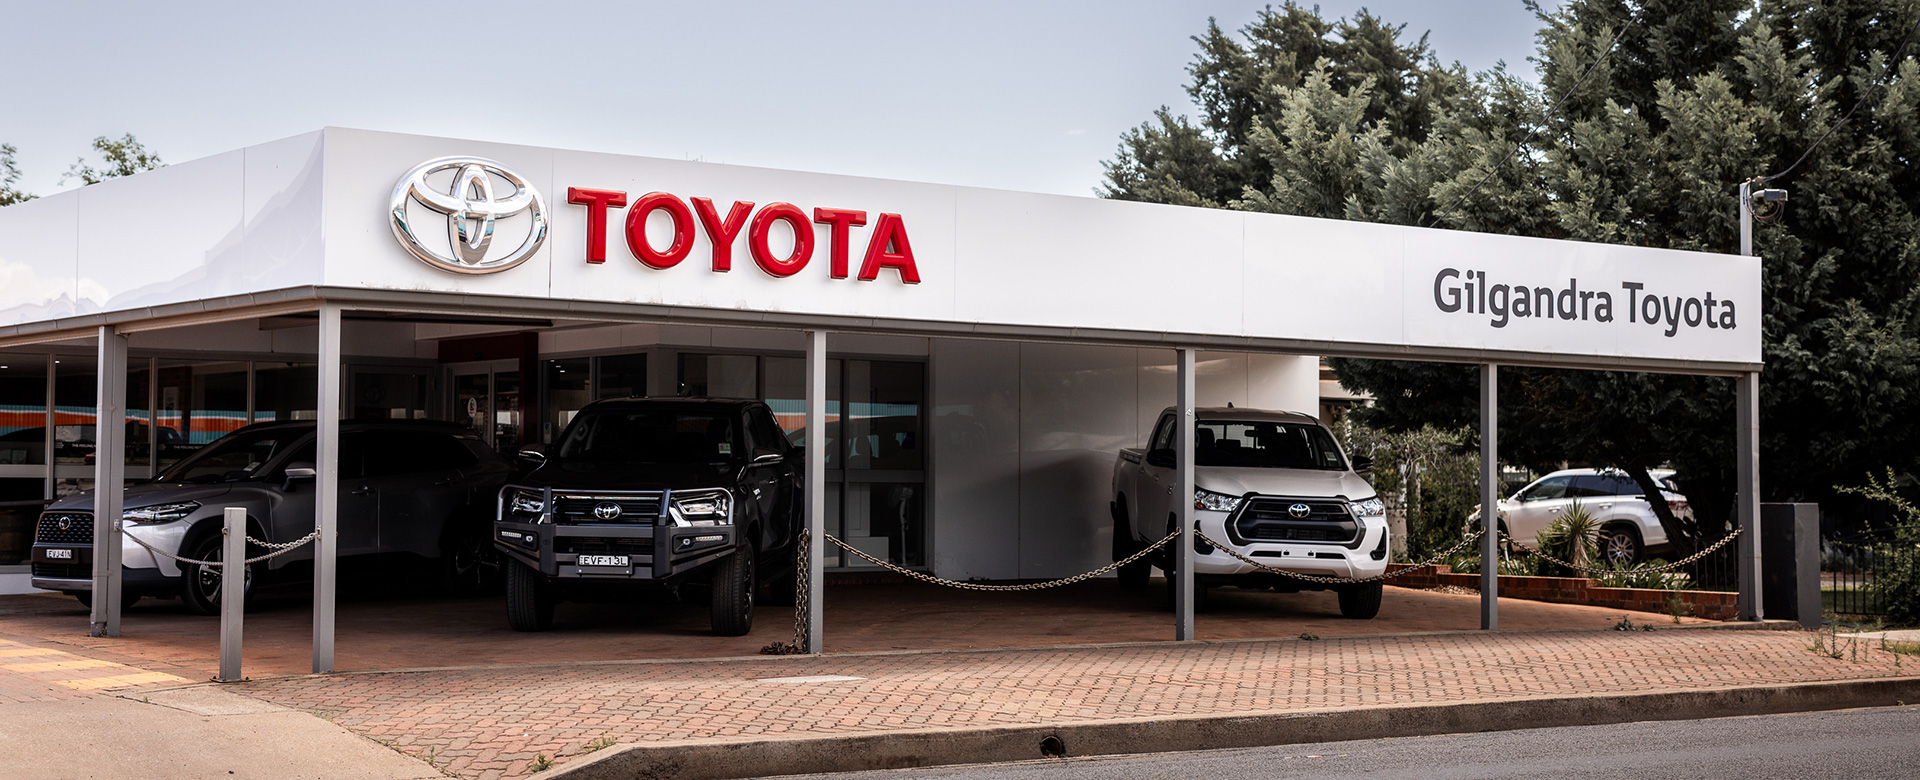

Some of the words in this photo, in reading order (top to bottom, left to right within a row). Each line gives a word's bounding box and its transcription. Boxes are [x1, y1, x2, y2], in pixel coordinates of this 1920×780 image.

[566, 186, 922, 285] TOYOTA
[1433, 267, 1614, 328] Gilgandra
[1622, 281, 1737, 338] Toyota
